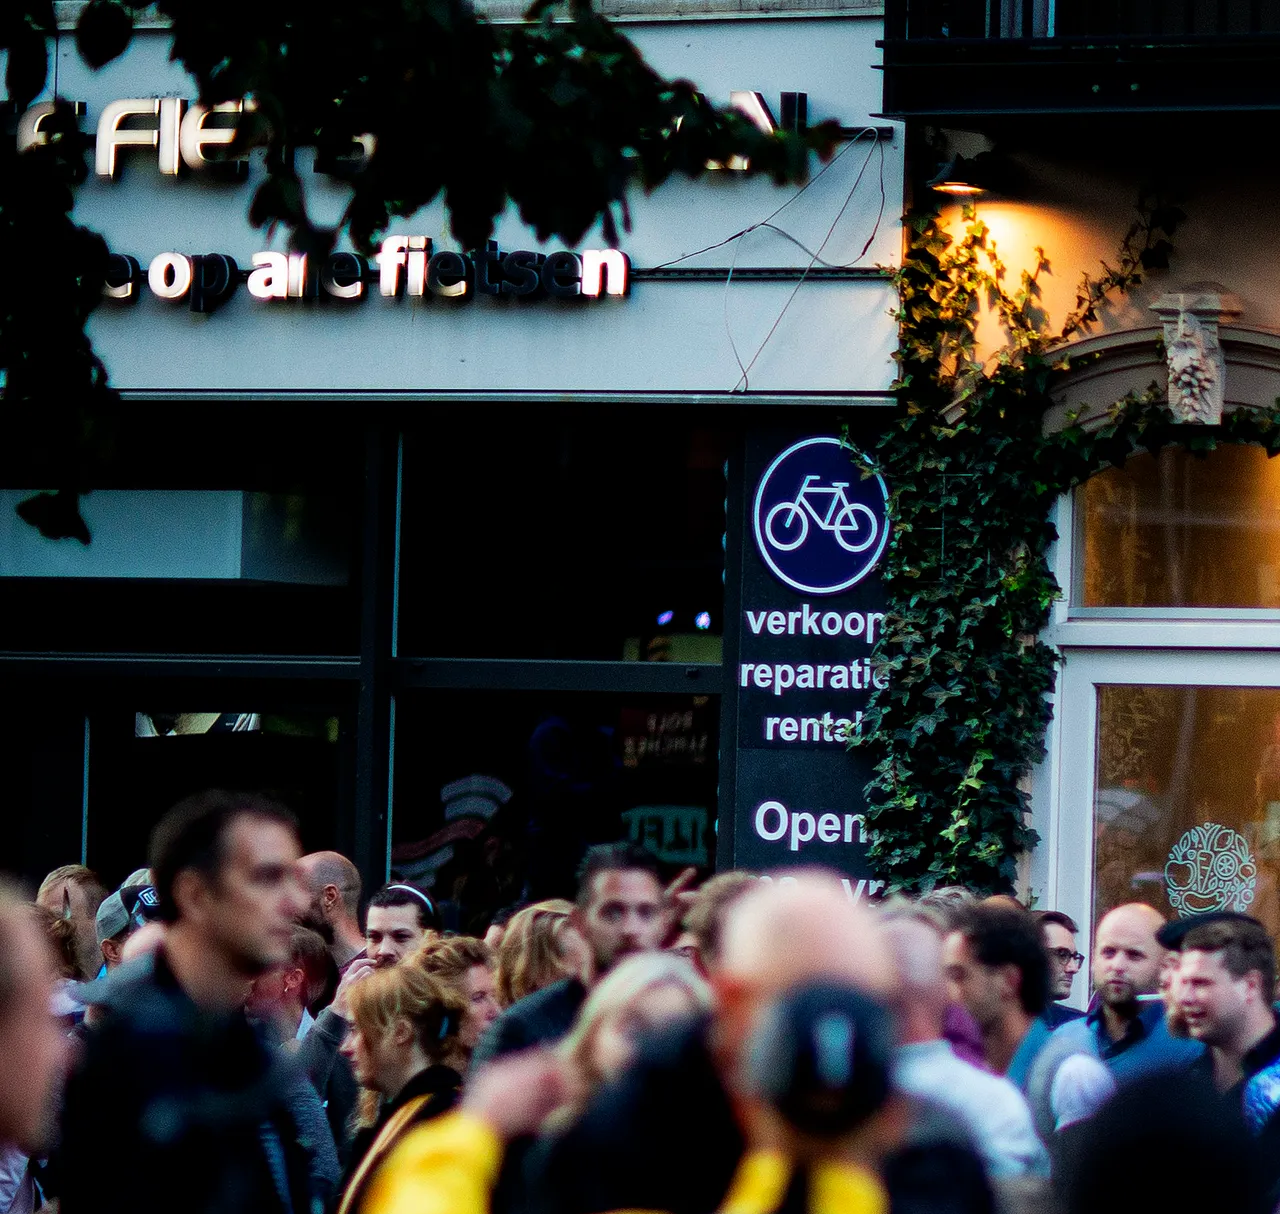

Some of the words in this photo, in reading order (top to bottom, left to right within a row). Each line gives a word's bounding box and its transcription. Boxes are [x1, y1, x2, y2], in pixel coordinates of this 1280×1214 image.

[147, 251, 236, 312] op
[376, 235, 630, 299] fietsen
[766, 711, 863, 742] rental
[755, 801, 868, 852] Open
